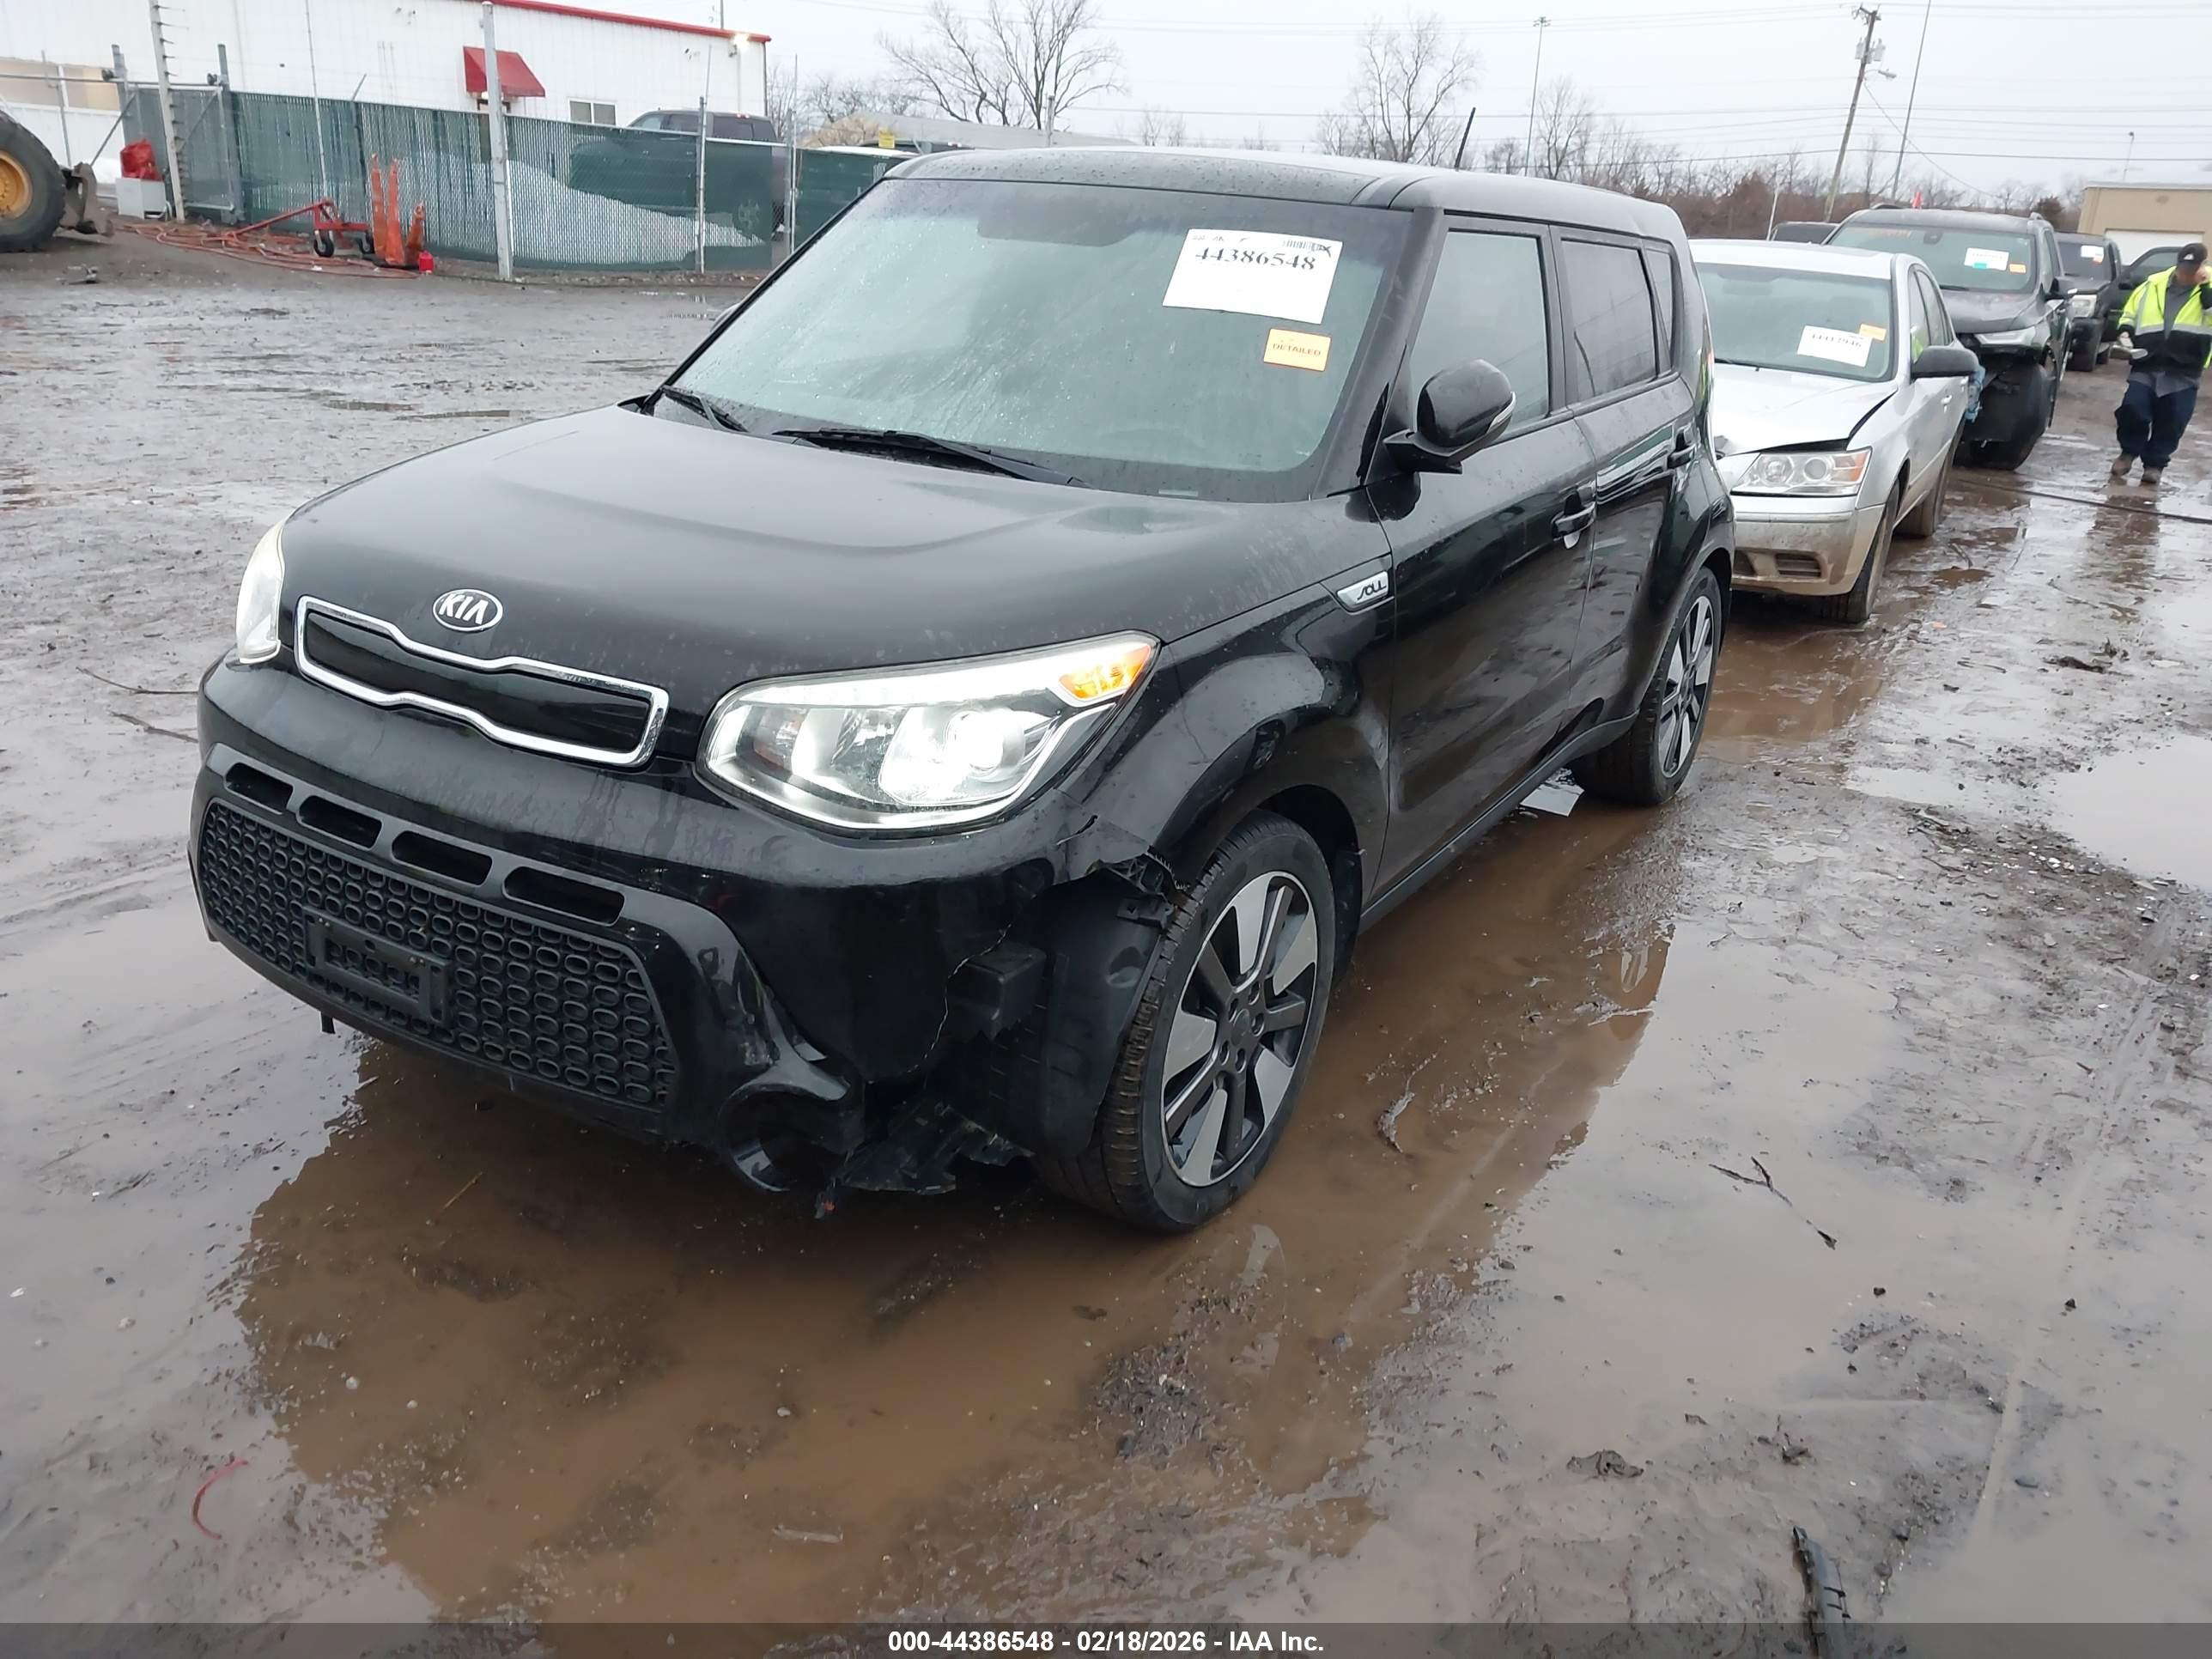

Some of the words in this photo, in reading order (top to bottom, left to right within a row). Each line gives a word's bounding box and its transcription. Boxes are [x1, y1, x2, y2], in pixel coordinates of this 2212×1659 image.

[1194, 246, 1316, 270] 44386548
[1272, 342, 1322, 356] DETAILED
[1357, 580, 1387, 601] SOUL
[438, 592, 489, 626] KIA
